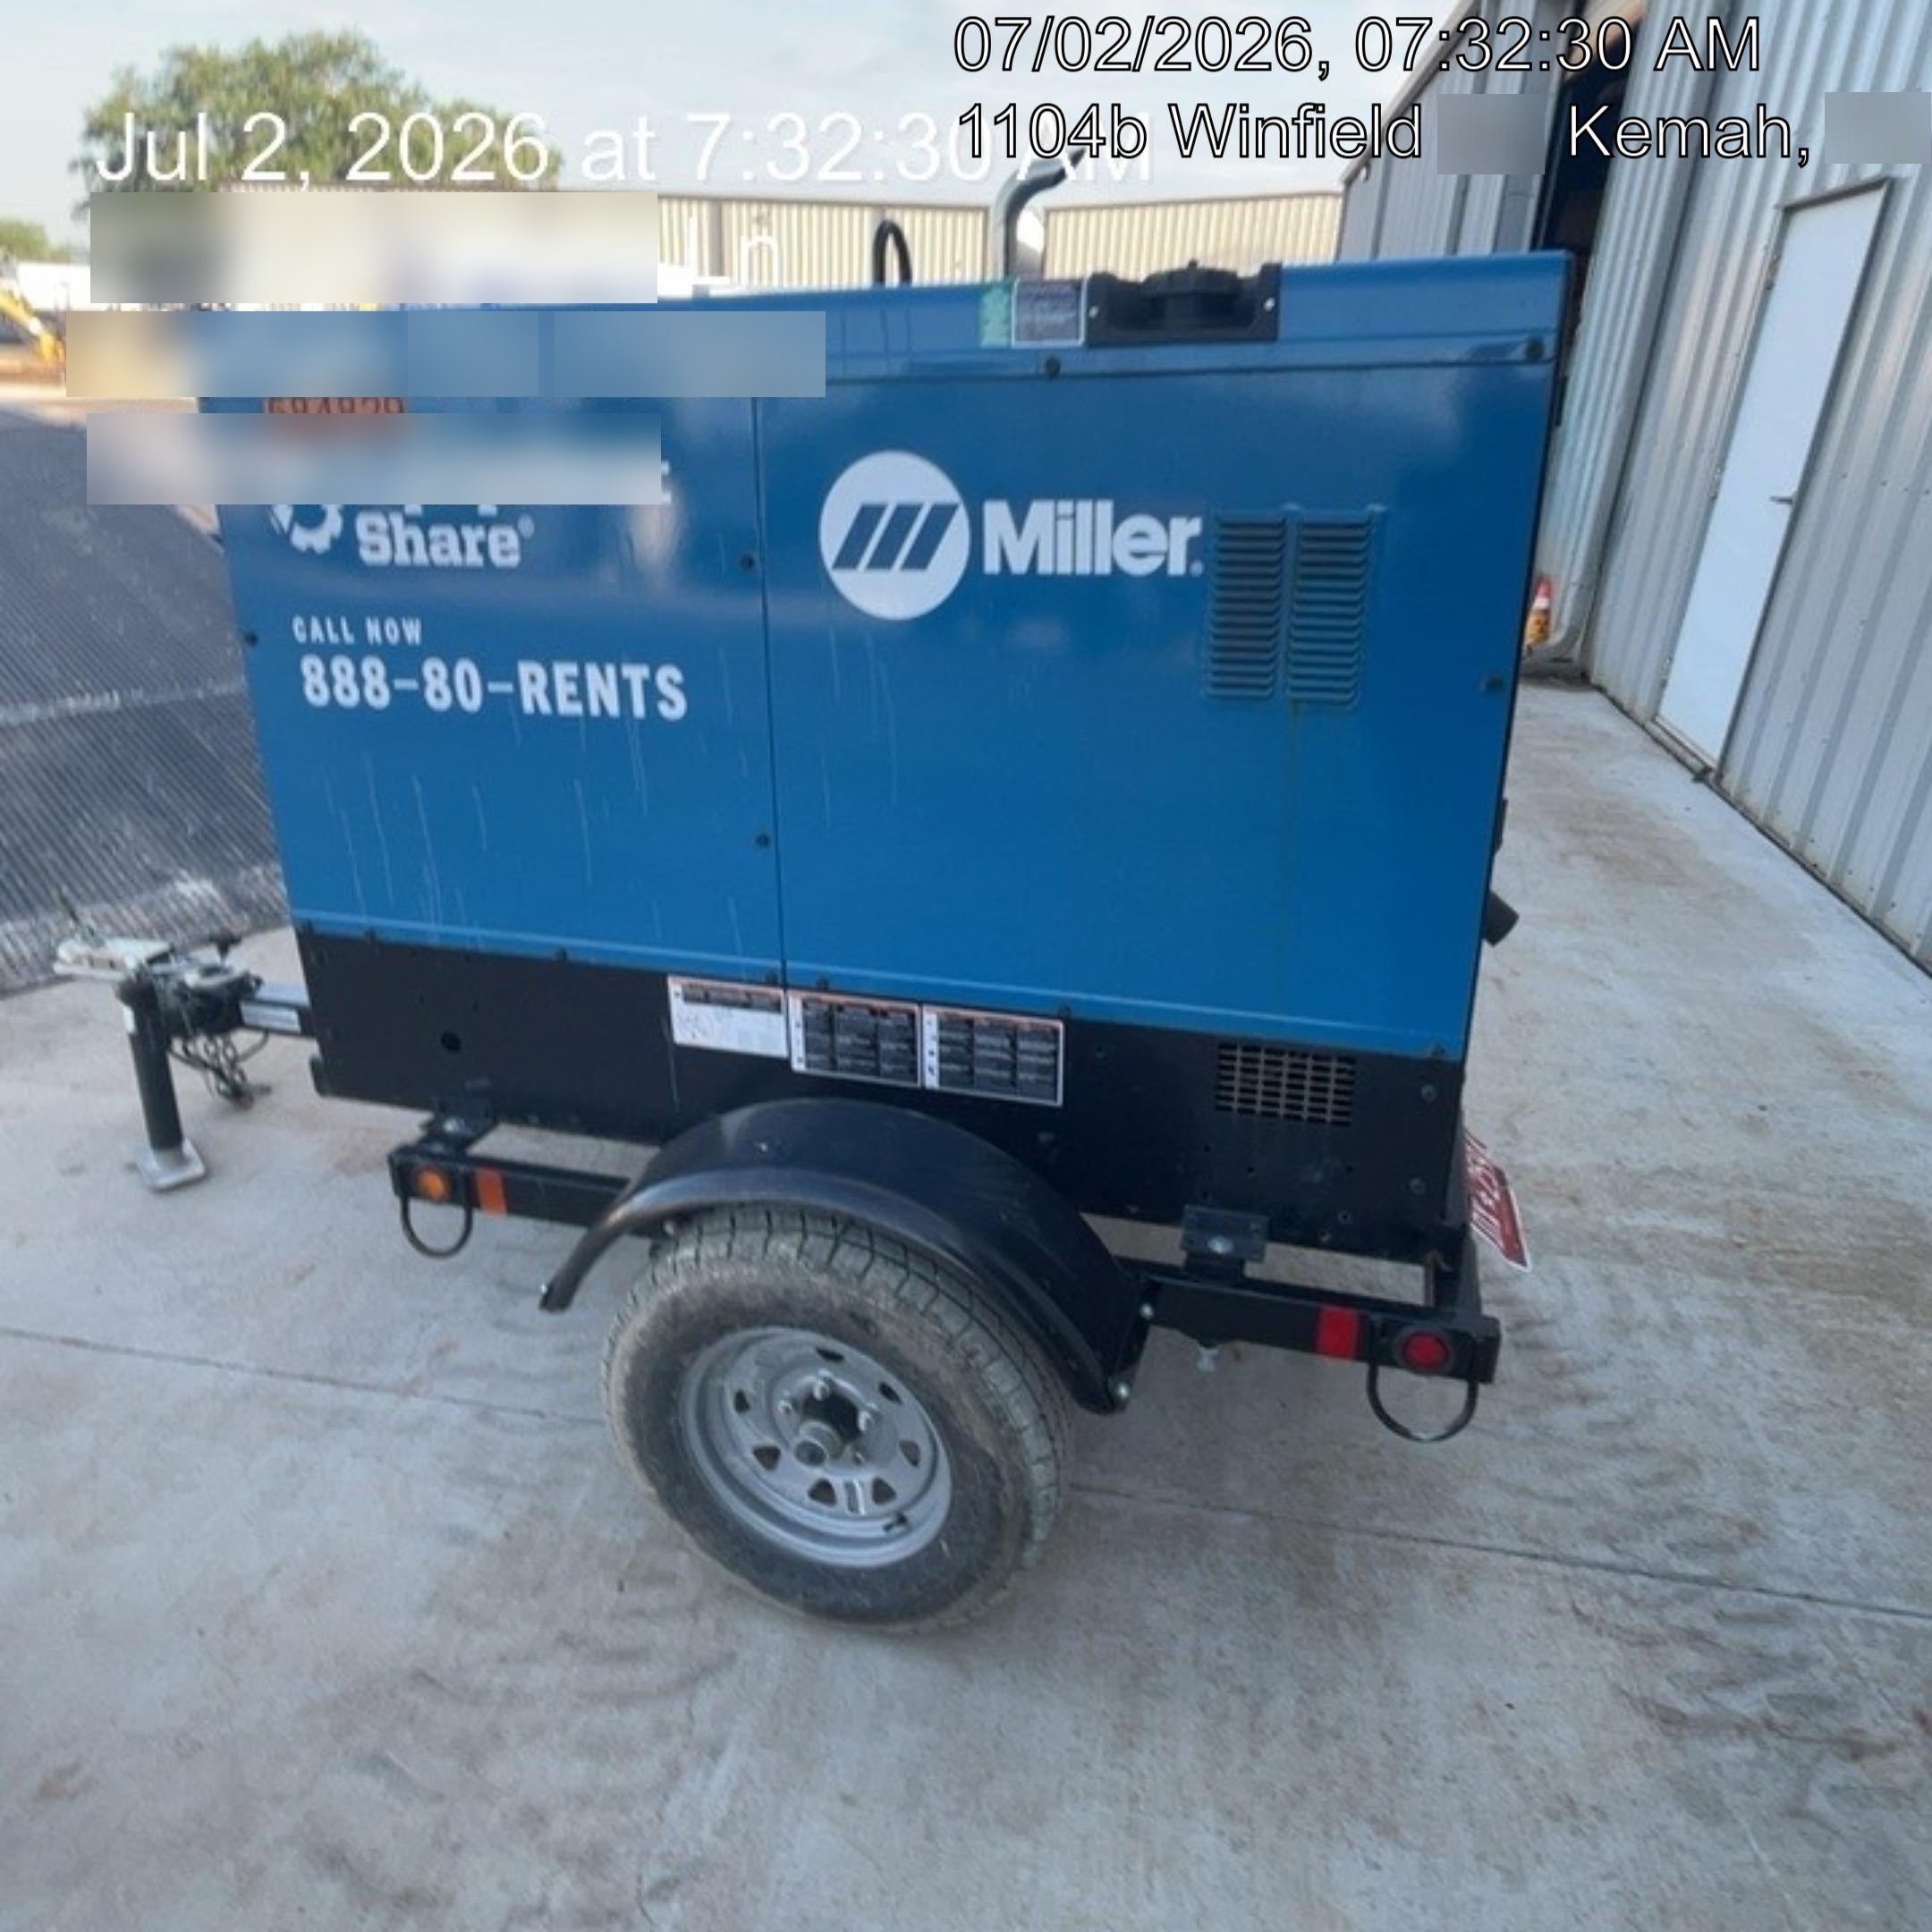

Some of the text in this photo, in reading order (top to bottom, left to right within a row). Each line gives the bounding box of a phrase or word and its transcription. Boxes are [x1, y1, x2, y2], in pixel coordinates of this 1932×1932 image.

[983, 499, 1202, 576] Miller
[292, 615, 423, 647] CALL NOW
[300, 654, 689, 721] 888-80-RENTS
